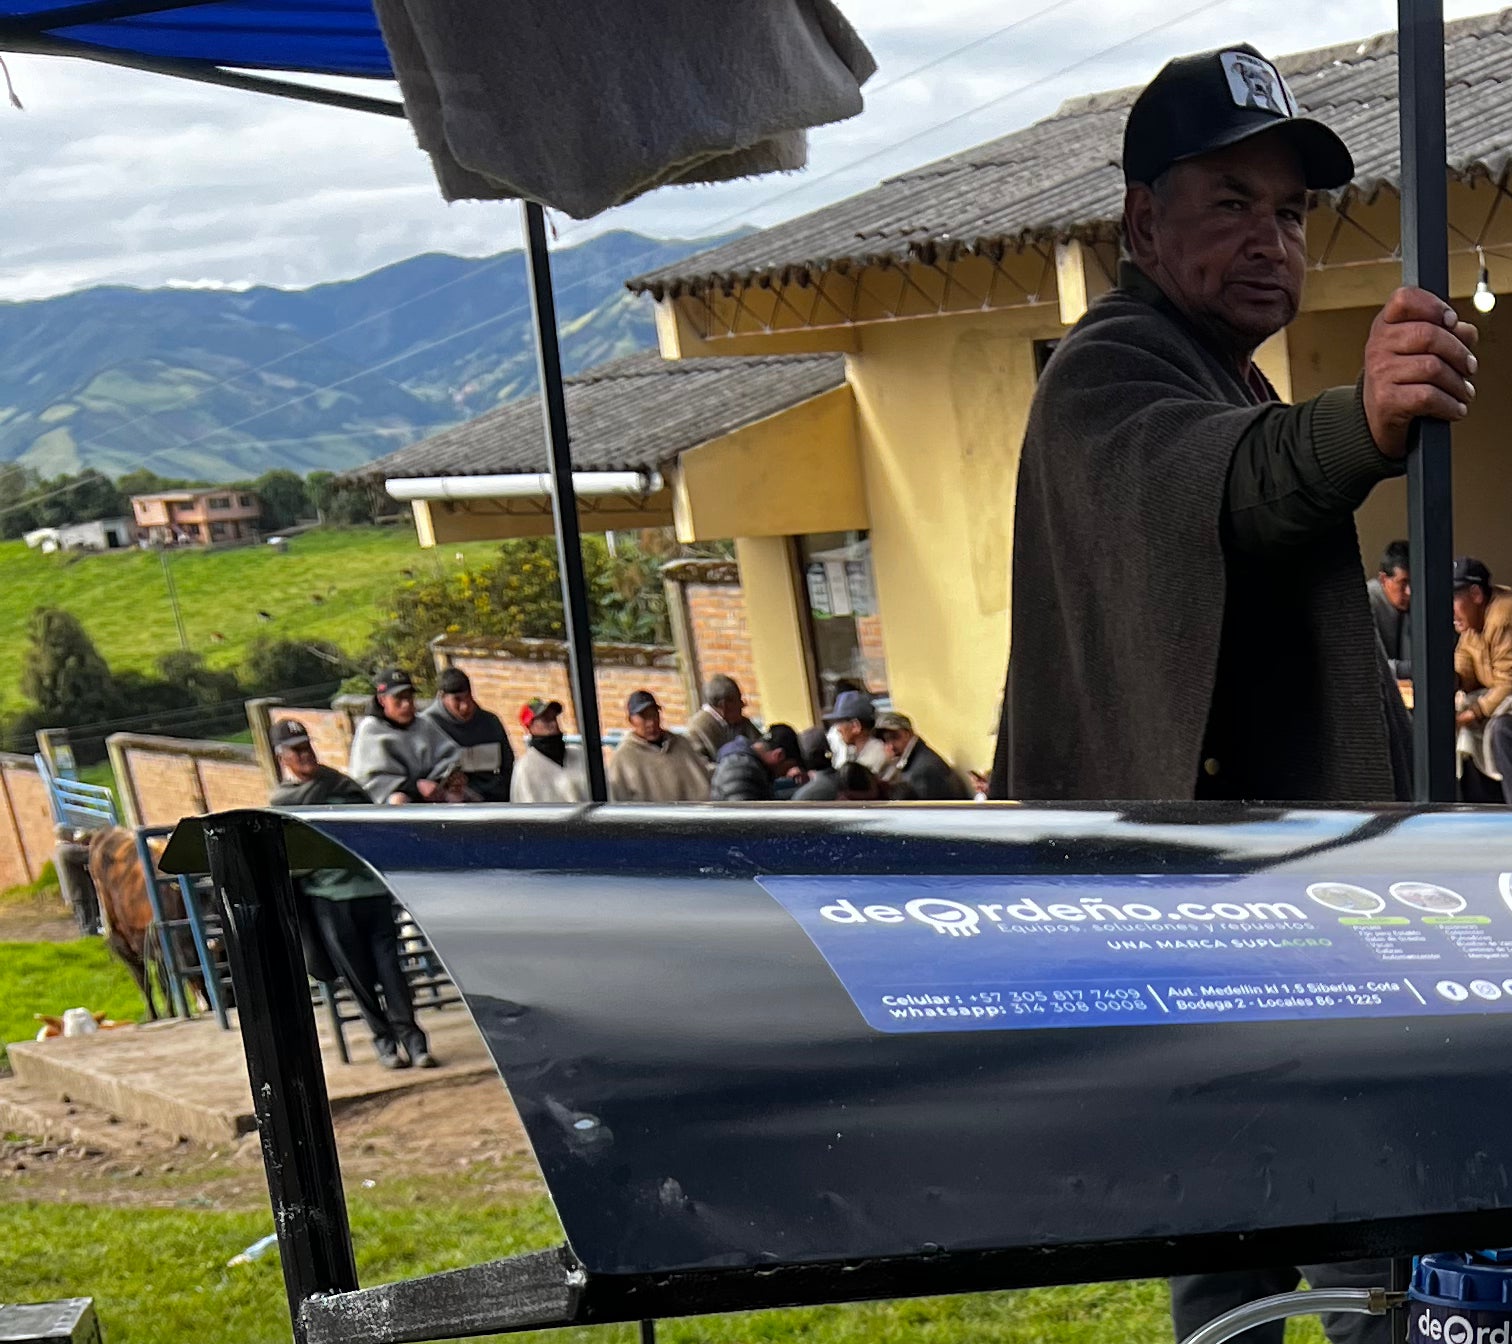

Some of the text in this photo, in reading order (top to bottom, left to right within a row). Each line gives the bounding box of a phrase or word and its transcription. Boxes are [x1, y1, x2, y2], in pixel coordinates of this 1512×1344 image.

[819, 897, 1308, 936] deOrdeño.com
[1107, 937, 1333, 950] UNA MARCA SUPLAGRO
[1366, 981, 1400, 992] Cota
[1008, 991, 1047, 1003] 305
[1053, 990, 1083, 1001] 817
[1090, 988, 1141, 1001] 7409
[1012, 1002, 1045, 1014] 314
[1053, 1001, 1090, 1013] 308
[1095, 1000, 1148, 1012] 0008
[1176, 999, 1233, 1012] Bodega
[1234, 998, 1246, 1009] 2
[1256, 996, 1313, 1009] Locales
[1345, 994, 1382, 1006] 1225
